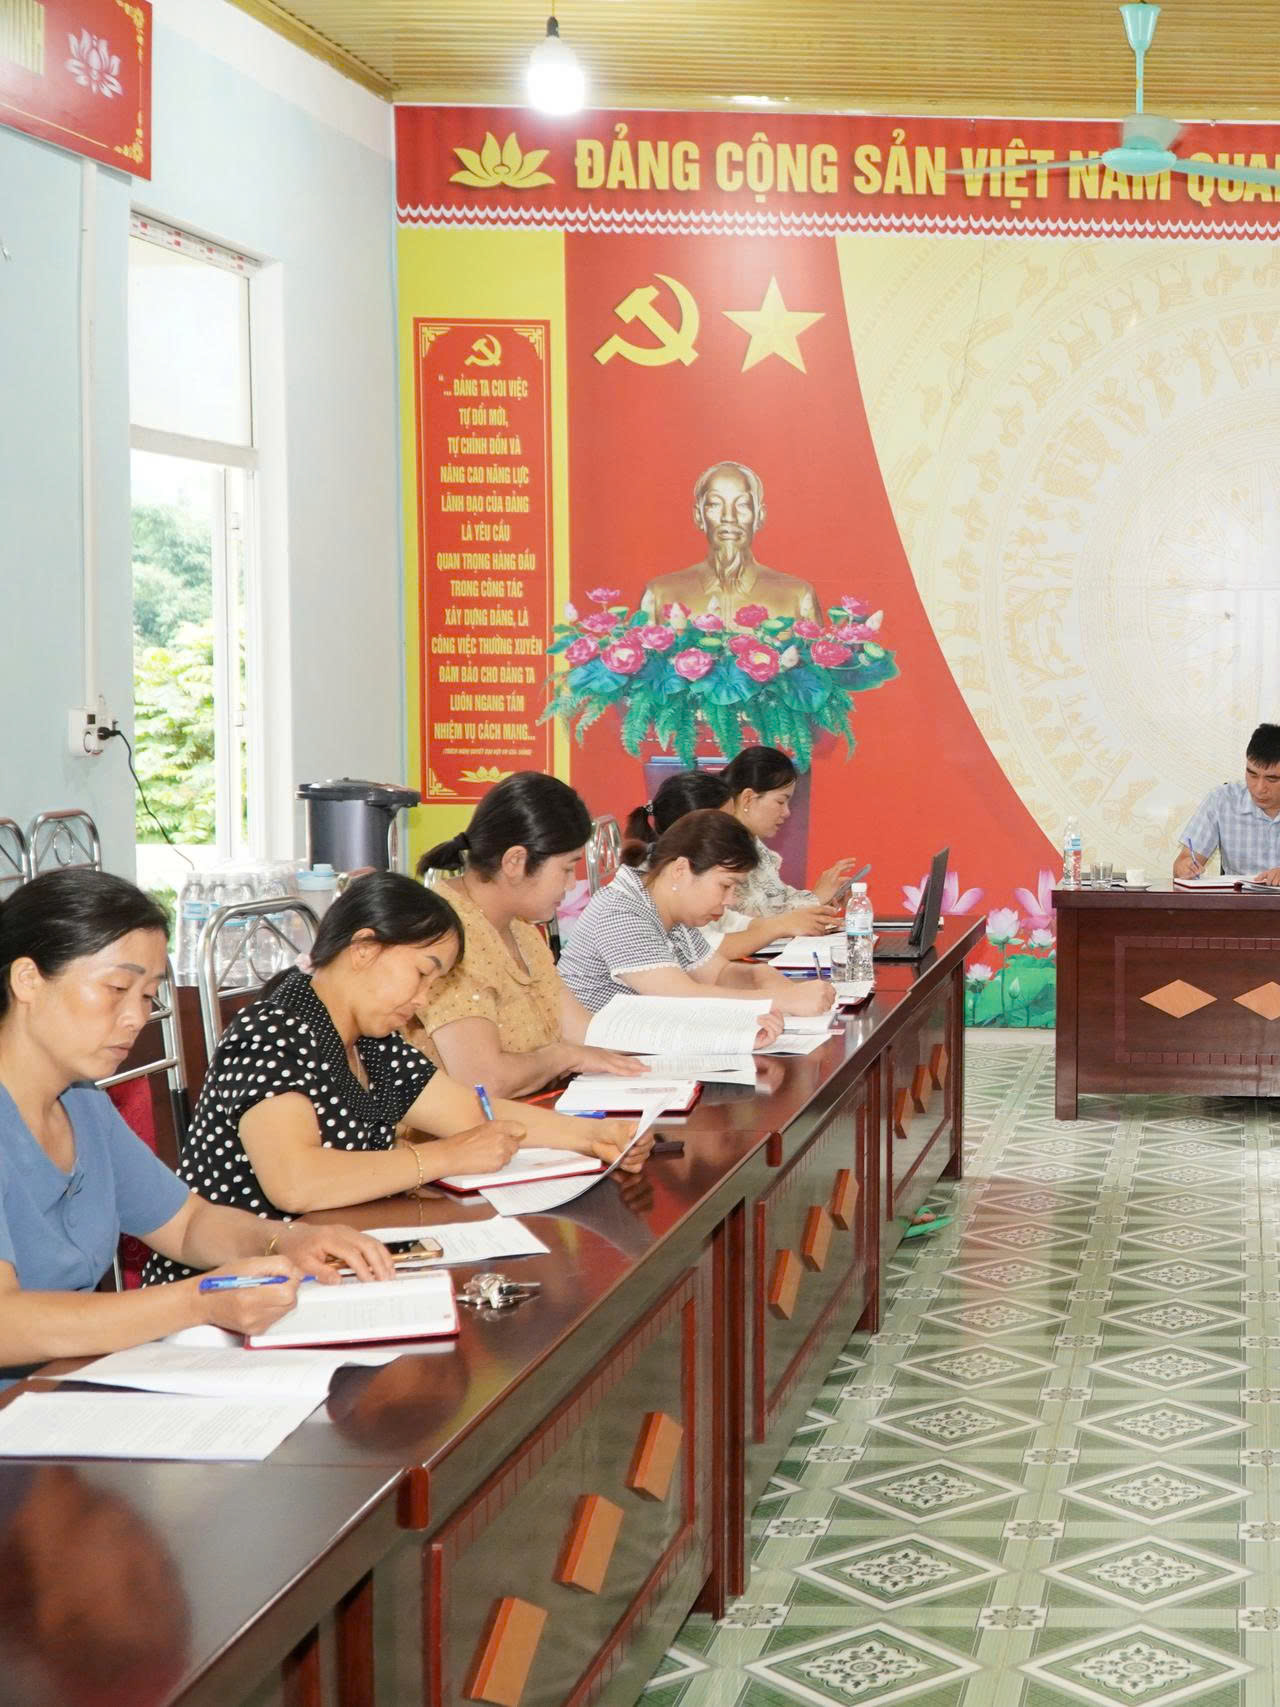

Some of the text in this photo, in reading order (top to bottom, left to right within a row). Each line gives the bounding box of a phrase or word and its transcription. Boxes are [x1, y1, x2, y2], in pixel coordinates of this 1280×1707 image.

[575, 123, 700, 190] ĐẢNG
[716, 132, 838, 203] CỘNG
[854, 128, 946, 195] SẢN
[961, 138, 1054, 209] VIỆT
[480, 379, 490, 397] TA
[491, 380, 506, 397] COI
[467, 466, 484, 483] CAO
[437, 552, 460, 571] QUAN
[450, 580, 479, 597] TRONG
[480, 666, 498, 683] CHO
[525, 667, 536, 684] TA
[474, 695, 505, 711] NGANG
